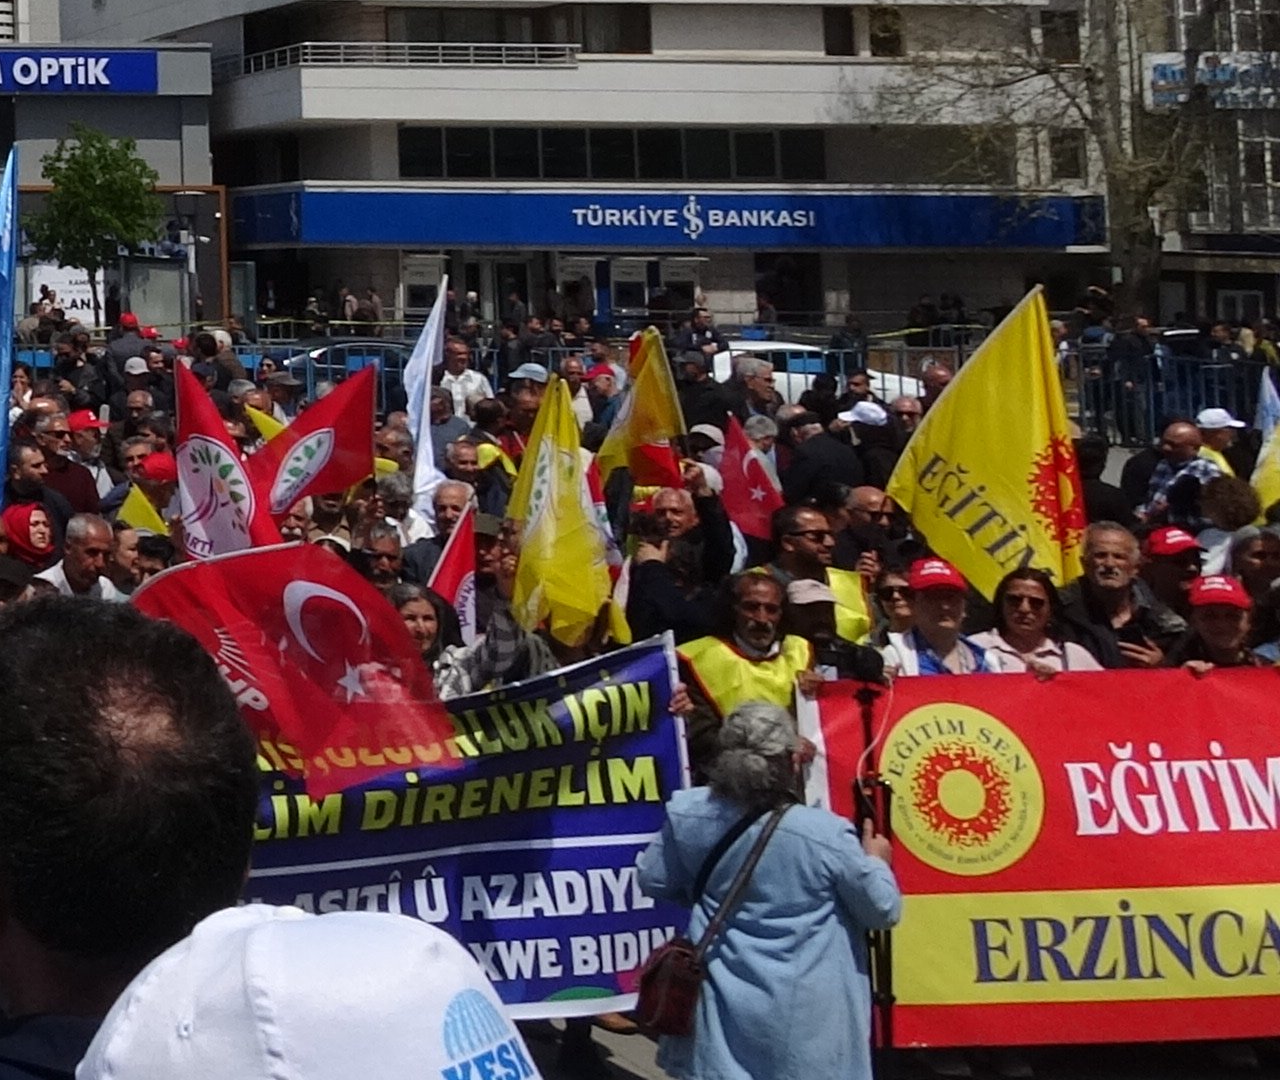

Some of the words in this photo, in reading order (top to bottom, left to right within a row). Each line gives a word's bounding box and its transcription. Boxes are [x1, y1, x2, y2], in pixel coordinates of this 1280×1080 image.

[572, 204, 679, 226] TÜRKİYE
[708, 209, 816, 228] BANKASI
[564, 668, 651, 746] İÇİN
[889, 713, 967, 780] EĞİTİM
[977, 726, 1028, 774] SEN
[359, 746, 661, 832] DİRENELİM
[412, 864, 451, 924] Û
[968, 899, 1280, 985] ERZİNCA
